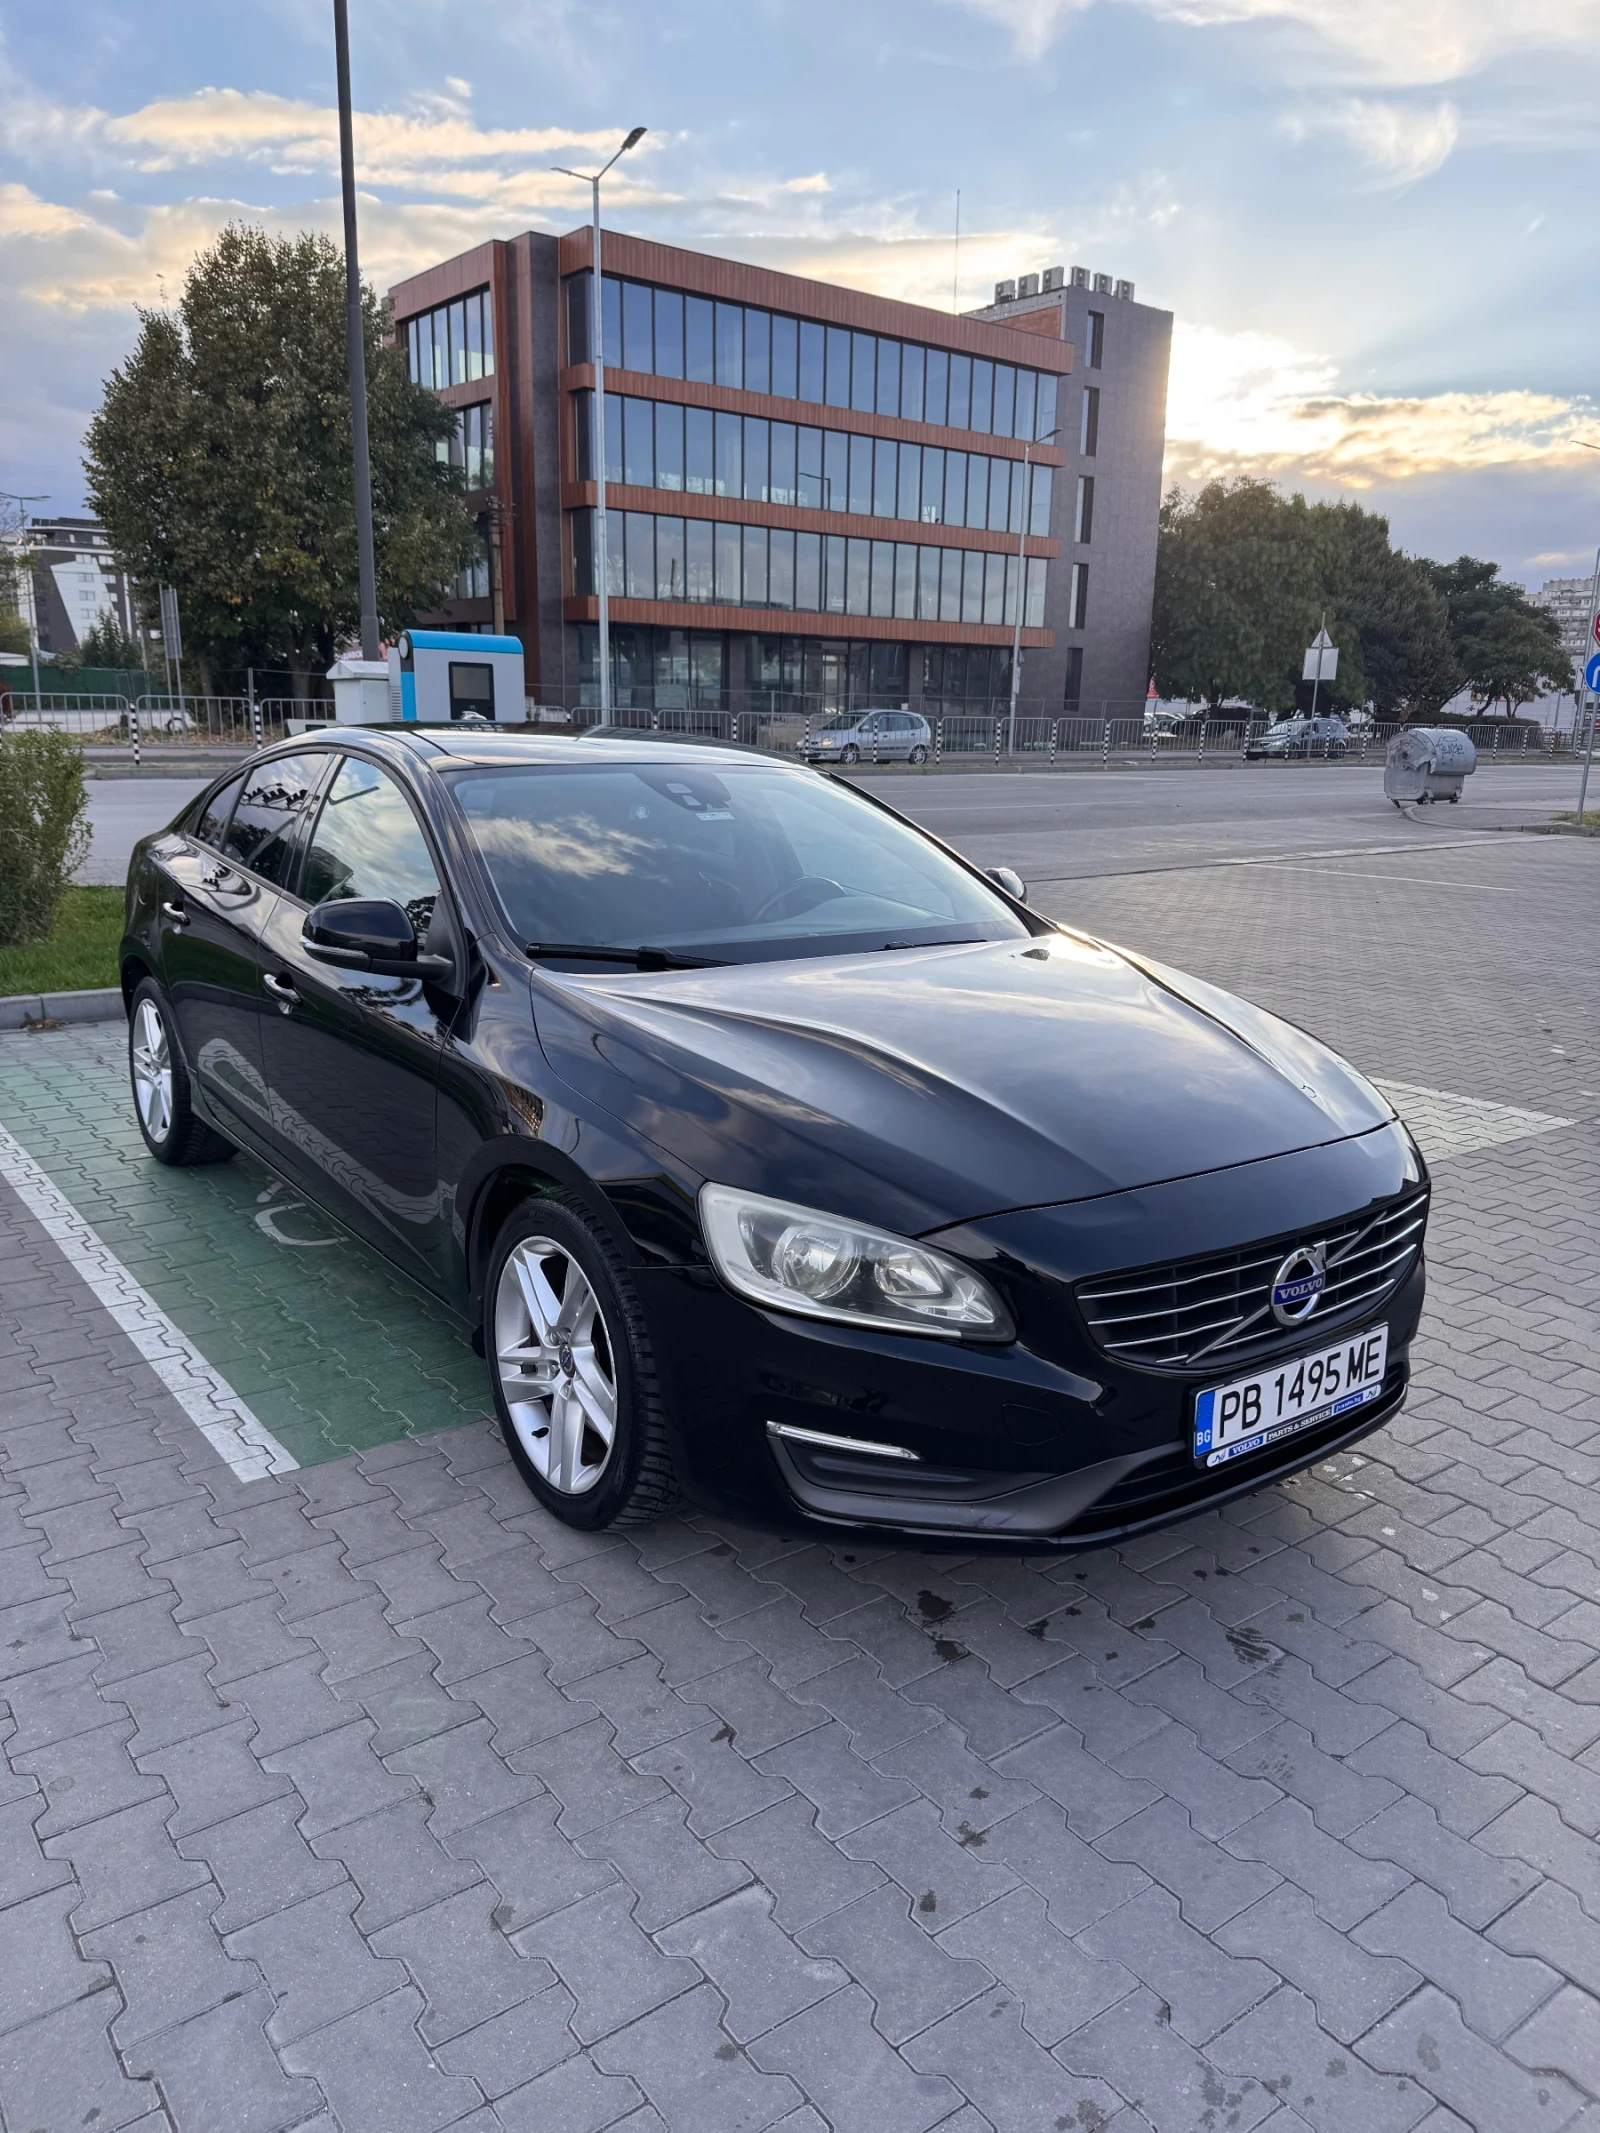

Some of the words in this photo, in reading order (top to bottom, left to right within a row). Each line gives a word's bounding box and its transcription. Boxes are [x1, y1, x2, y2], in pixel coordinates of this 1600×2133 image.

[1278, 1277, 1323, 1299] VOLVO
[1219, 1383, 1262, 1439] PB
[1275, 1352, 1341, 1416] 1495
[1346, 1335, 1382, 1388] ME
[1197, 1429, 1211, 1446] BG
[1232, 1438, 1260, 1454] VOLVO
[1268, 1424, 1293, 1440] PARTS
[1300, 1409, 1331, 1428] SERVICE
